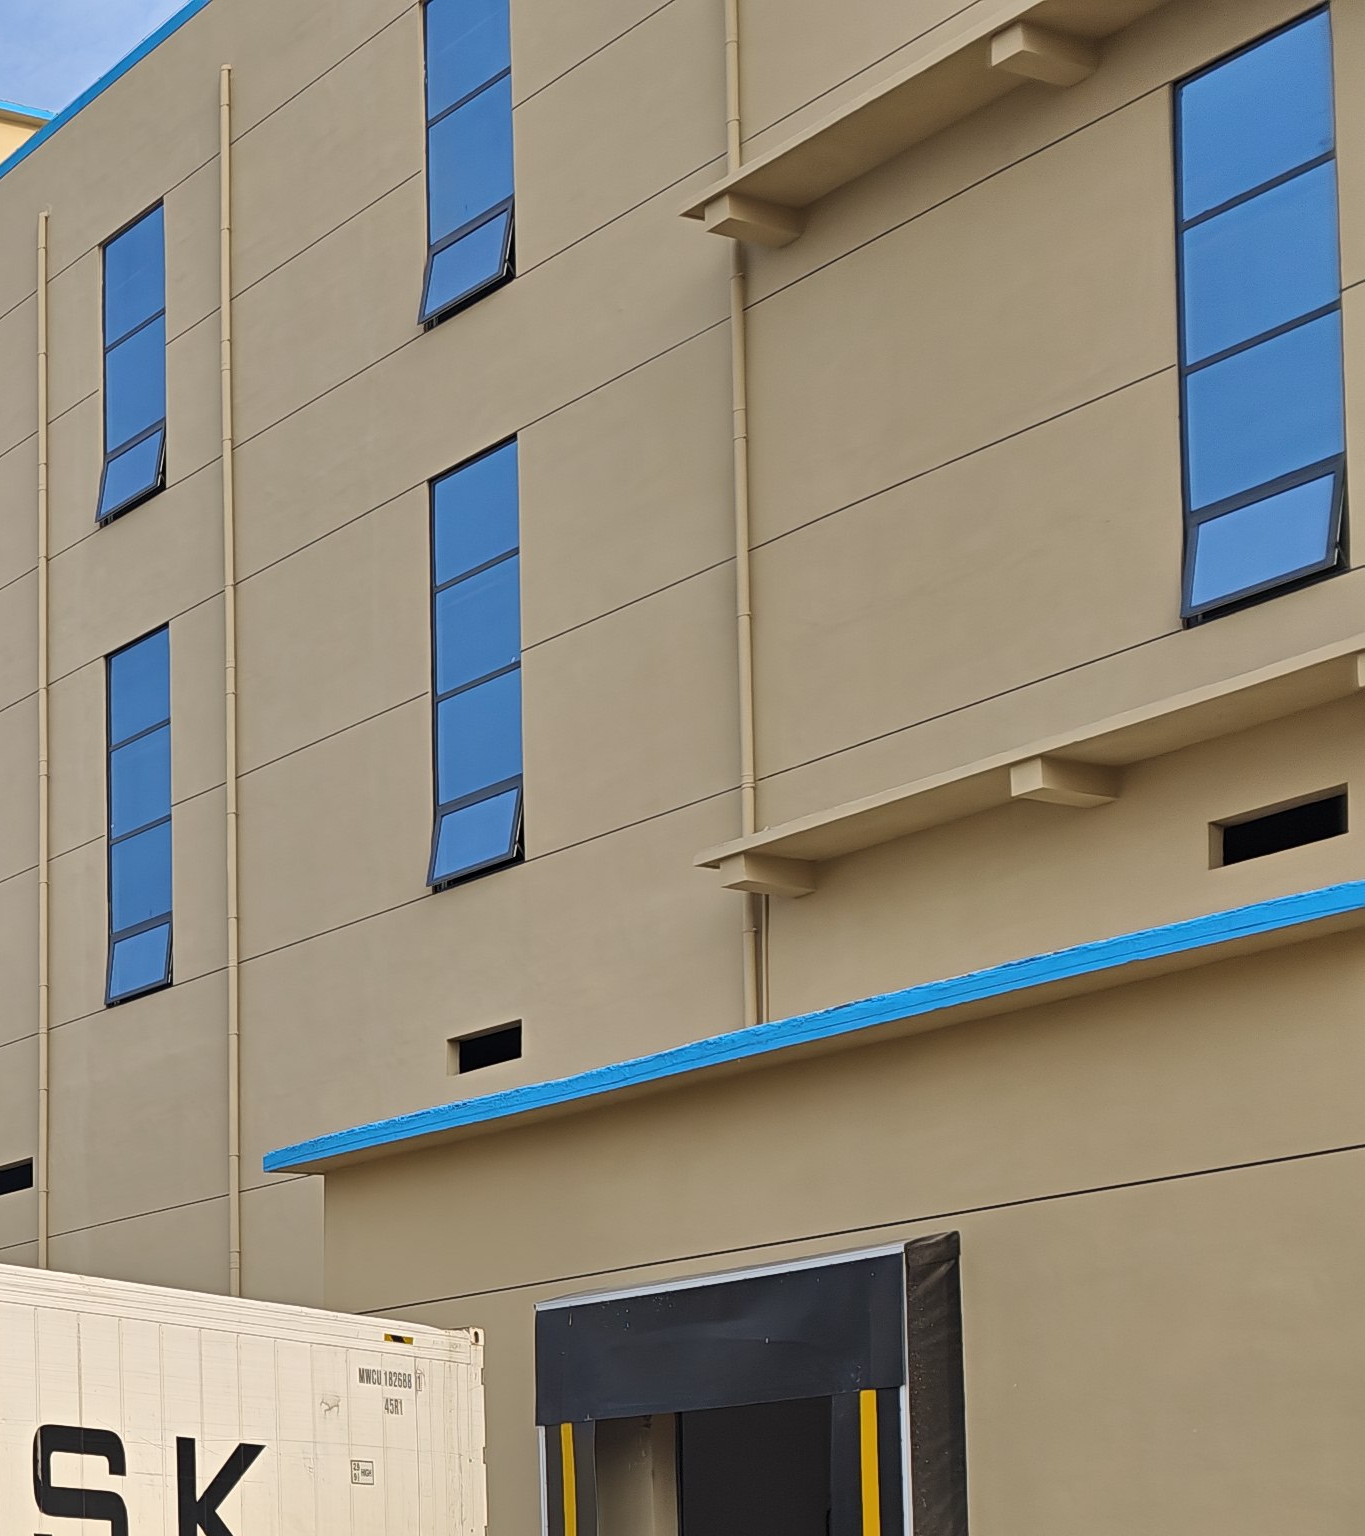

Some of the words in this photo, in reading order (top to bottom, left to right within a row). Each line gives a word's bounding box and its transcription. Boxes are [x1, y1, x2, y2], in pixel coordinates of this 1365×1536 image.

[358, 1367, 382, 1386] MWCU
[383, 1371, 412, 1389] 182688
[384, 1397, 404, 1415] 45R1
